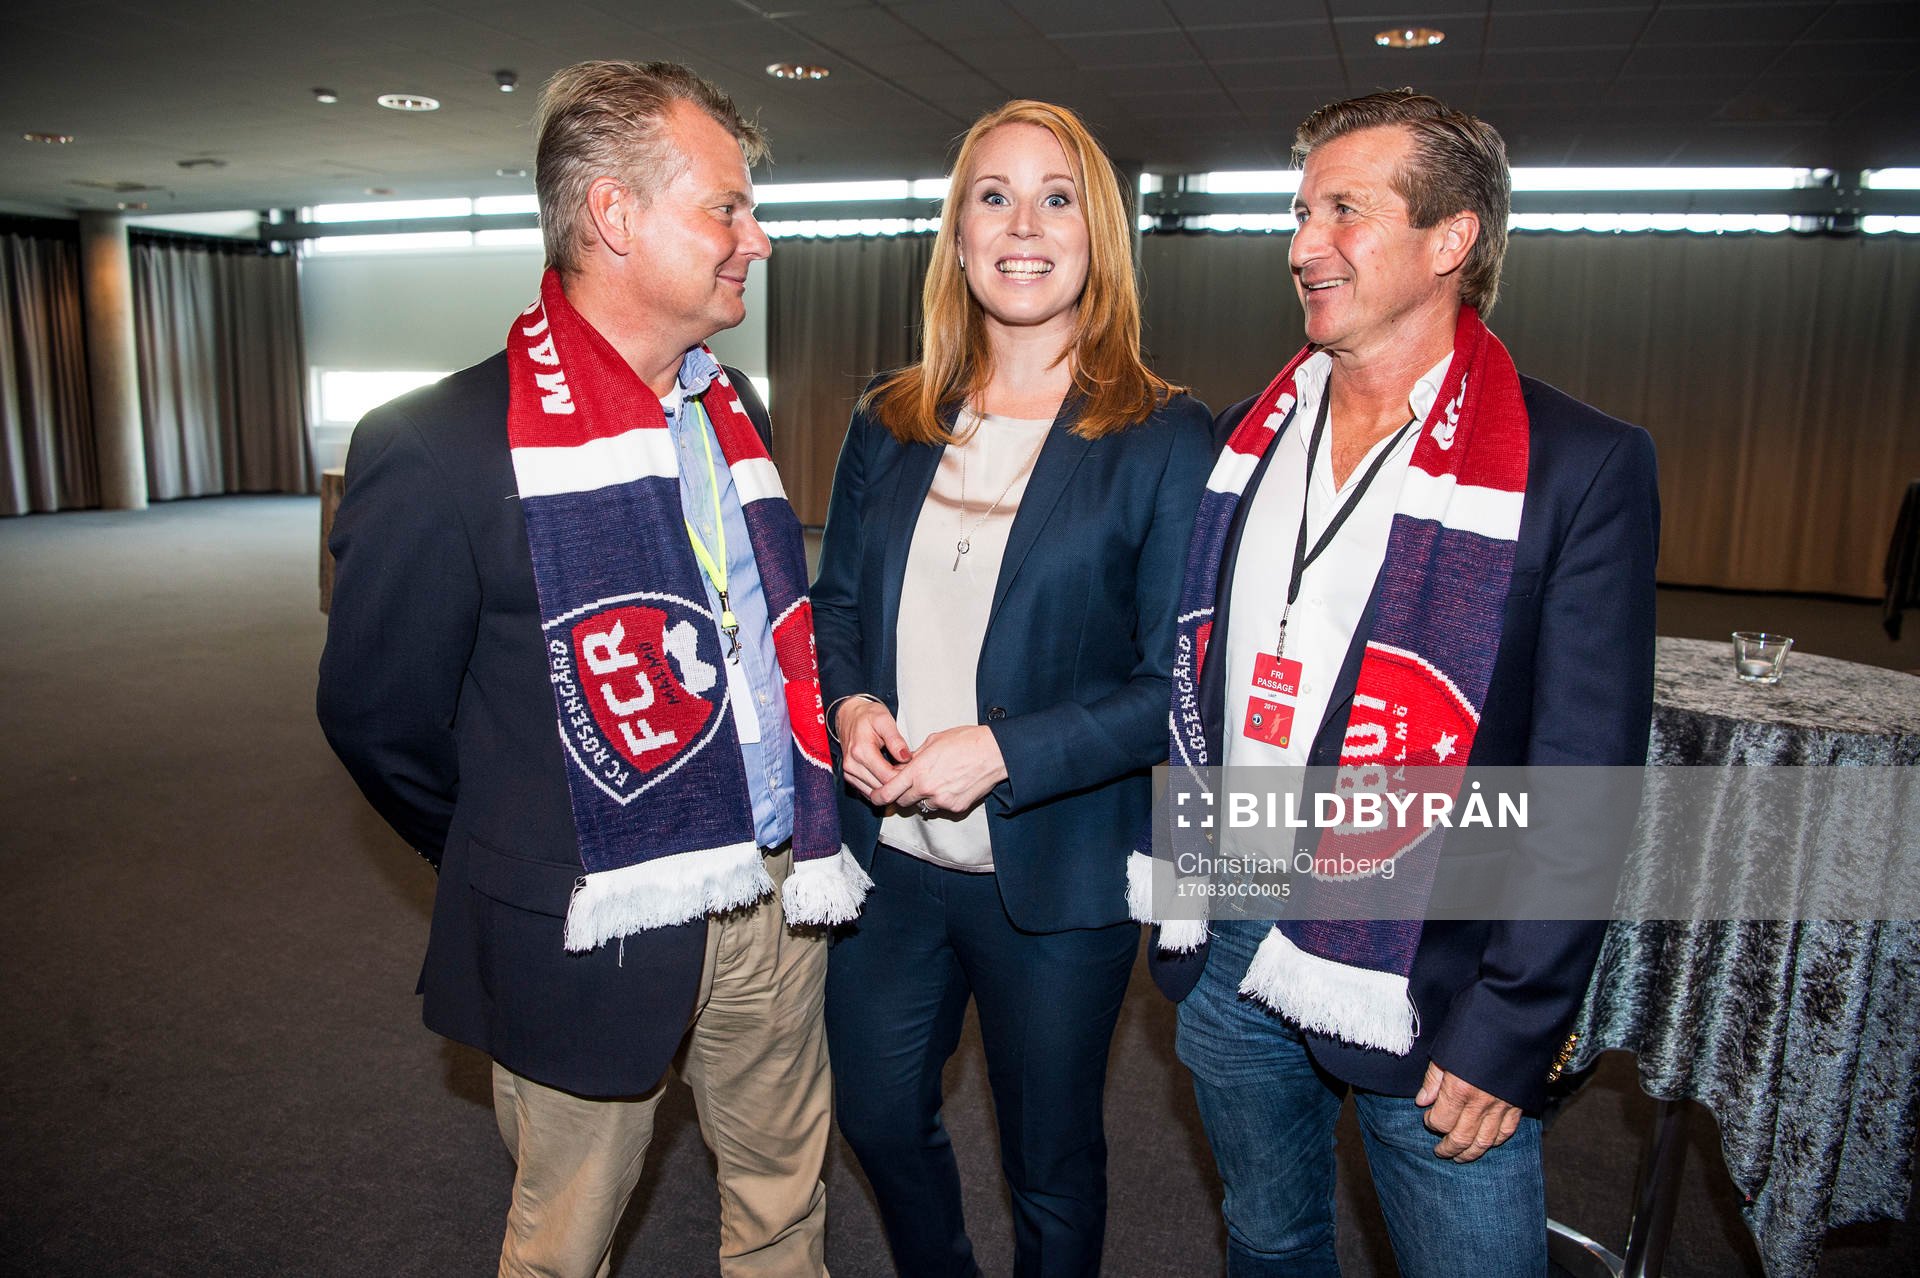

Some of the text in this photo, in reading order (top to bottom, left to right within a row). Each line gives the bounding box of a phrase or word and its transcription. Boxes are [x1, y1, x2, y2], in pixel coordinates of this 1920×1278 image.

[1270, 670, 1284, 680] FRI
[581, 619, 678, 756] FCR
[1257, 677, 1294, 693] PASSAGE
[550, 639, 609, 767] ROSENGÅRD
[1264, 703, 1277, 711] 2017
